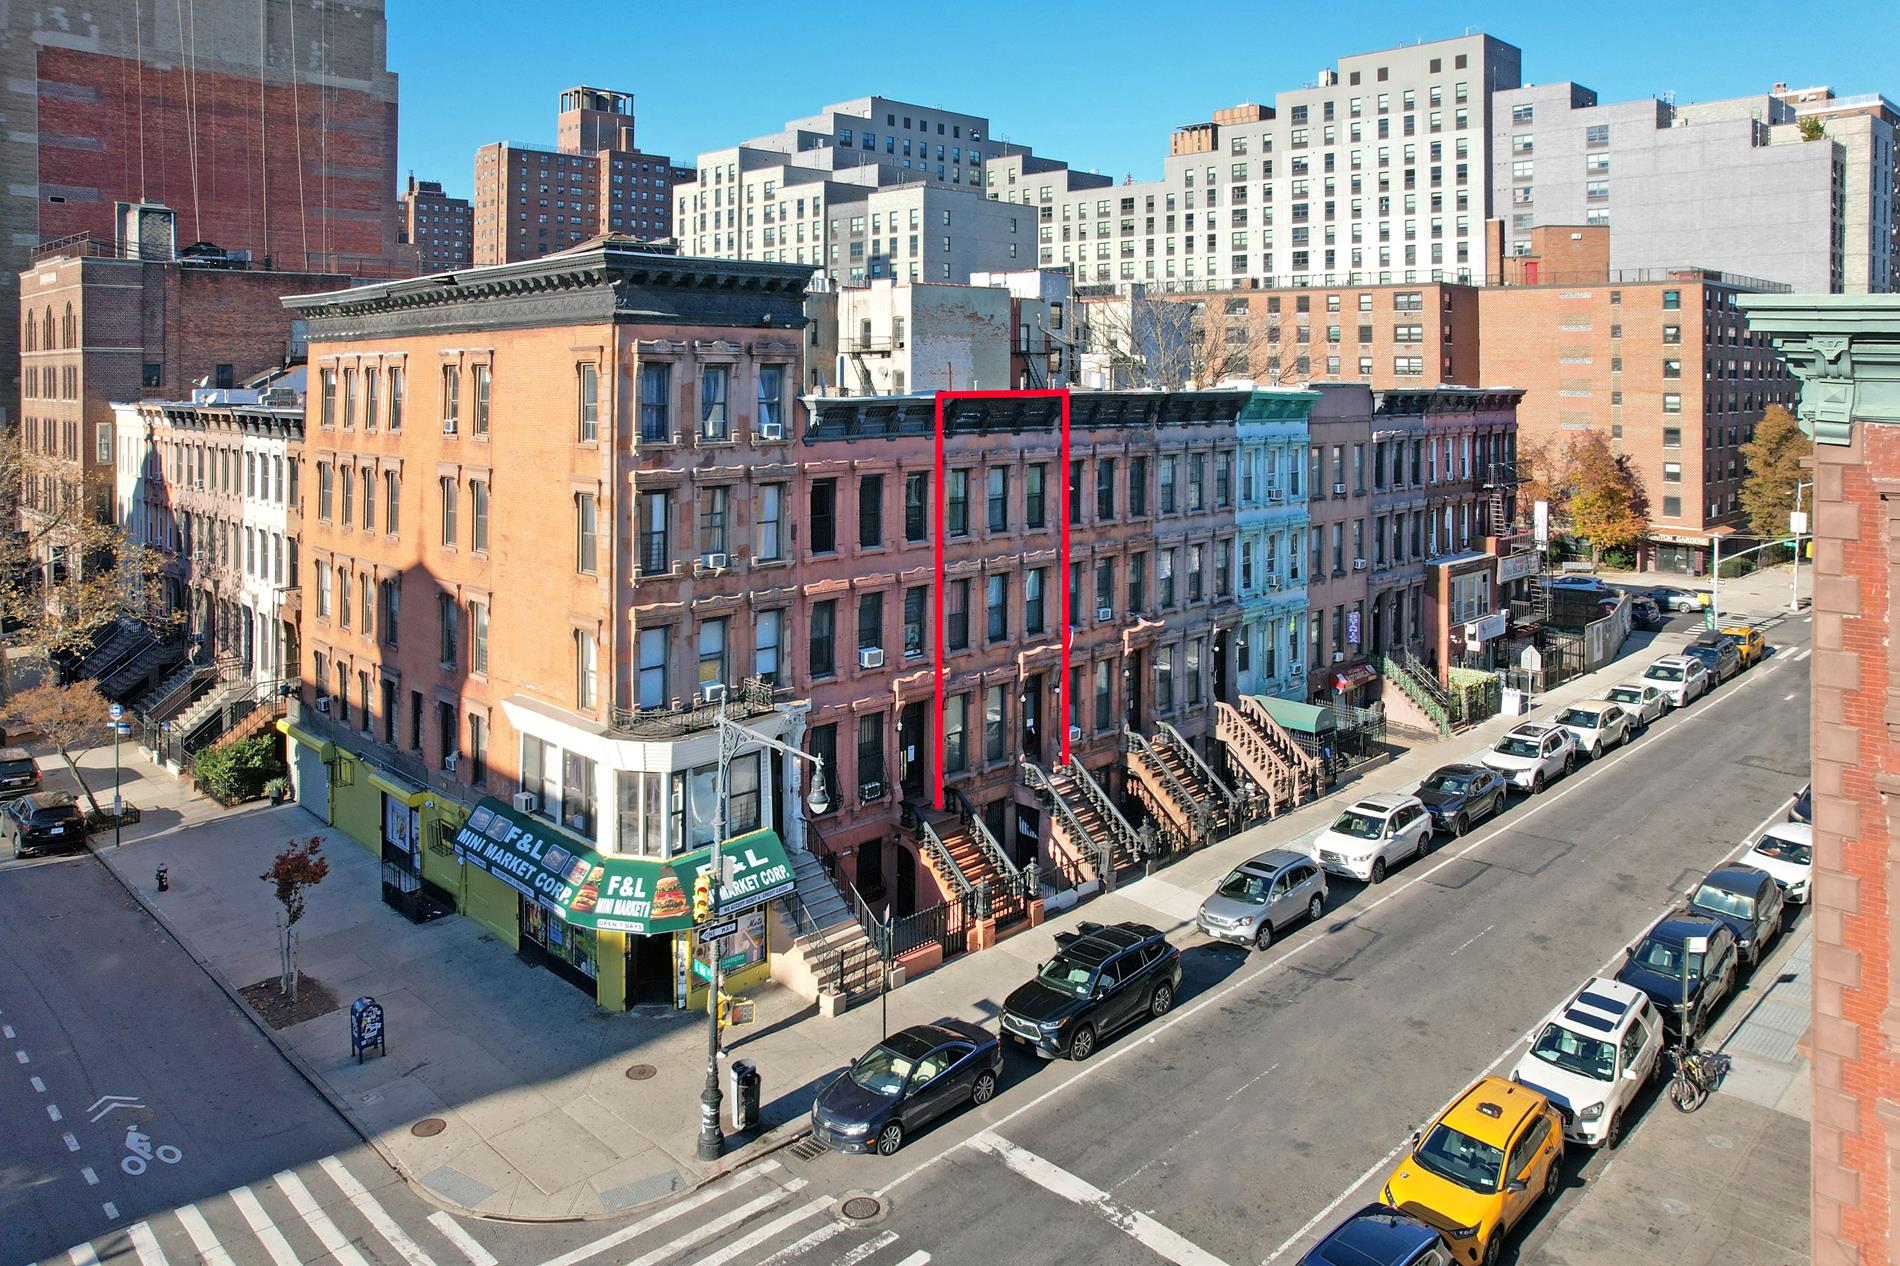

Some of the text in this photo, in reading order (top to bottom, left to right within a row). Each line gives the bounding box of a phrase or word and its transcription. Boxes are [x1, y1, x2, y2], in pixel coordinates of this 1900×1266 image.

[456, 828, 487, 853] MINI
[483, 842, 537, 880] MARKET
[534, 872, 573, 905] CORP.
[719, 874, 760, 901] MARKET
[760, 864, 790, 886] CORP.
[595, 897, 615, 914] MINI
[704, 930, 716, 939] ONE
[721, 925, 734, 933] WAY
[721, 954, 745, 966] Lexington
